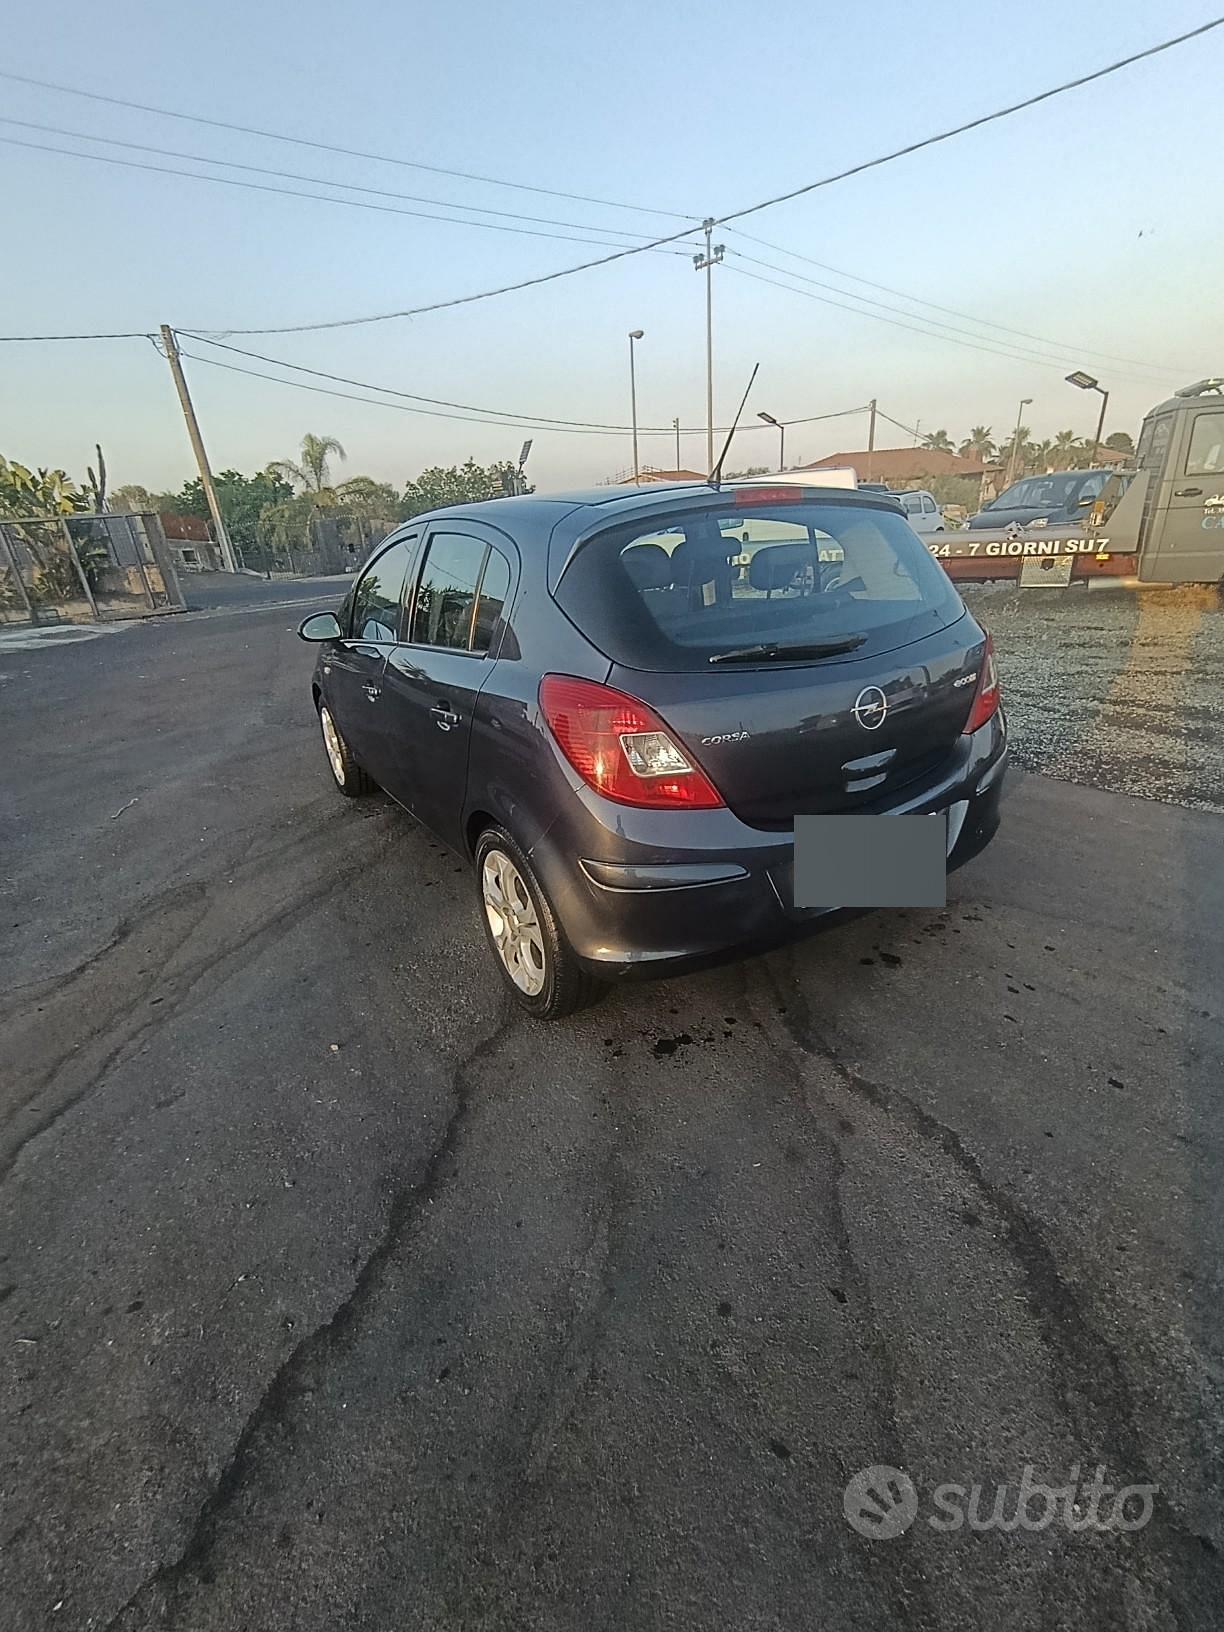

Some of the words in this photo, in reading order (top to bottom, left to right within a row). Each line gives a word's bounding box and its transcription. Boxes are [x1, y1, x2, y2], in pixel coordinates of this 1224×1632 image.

[968, 543, 981, 556] 7
[985, 540, 1060, 556] GIORNI
[701, 731, 751, 746] CORSA
